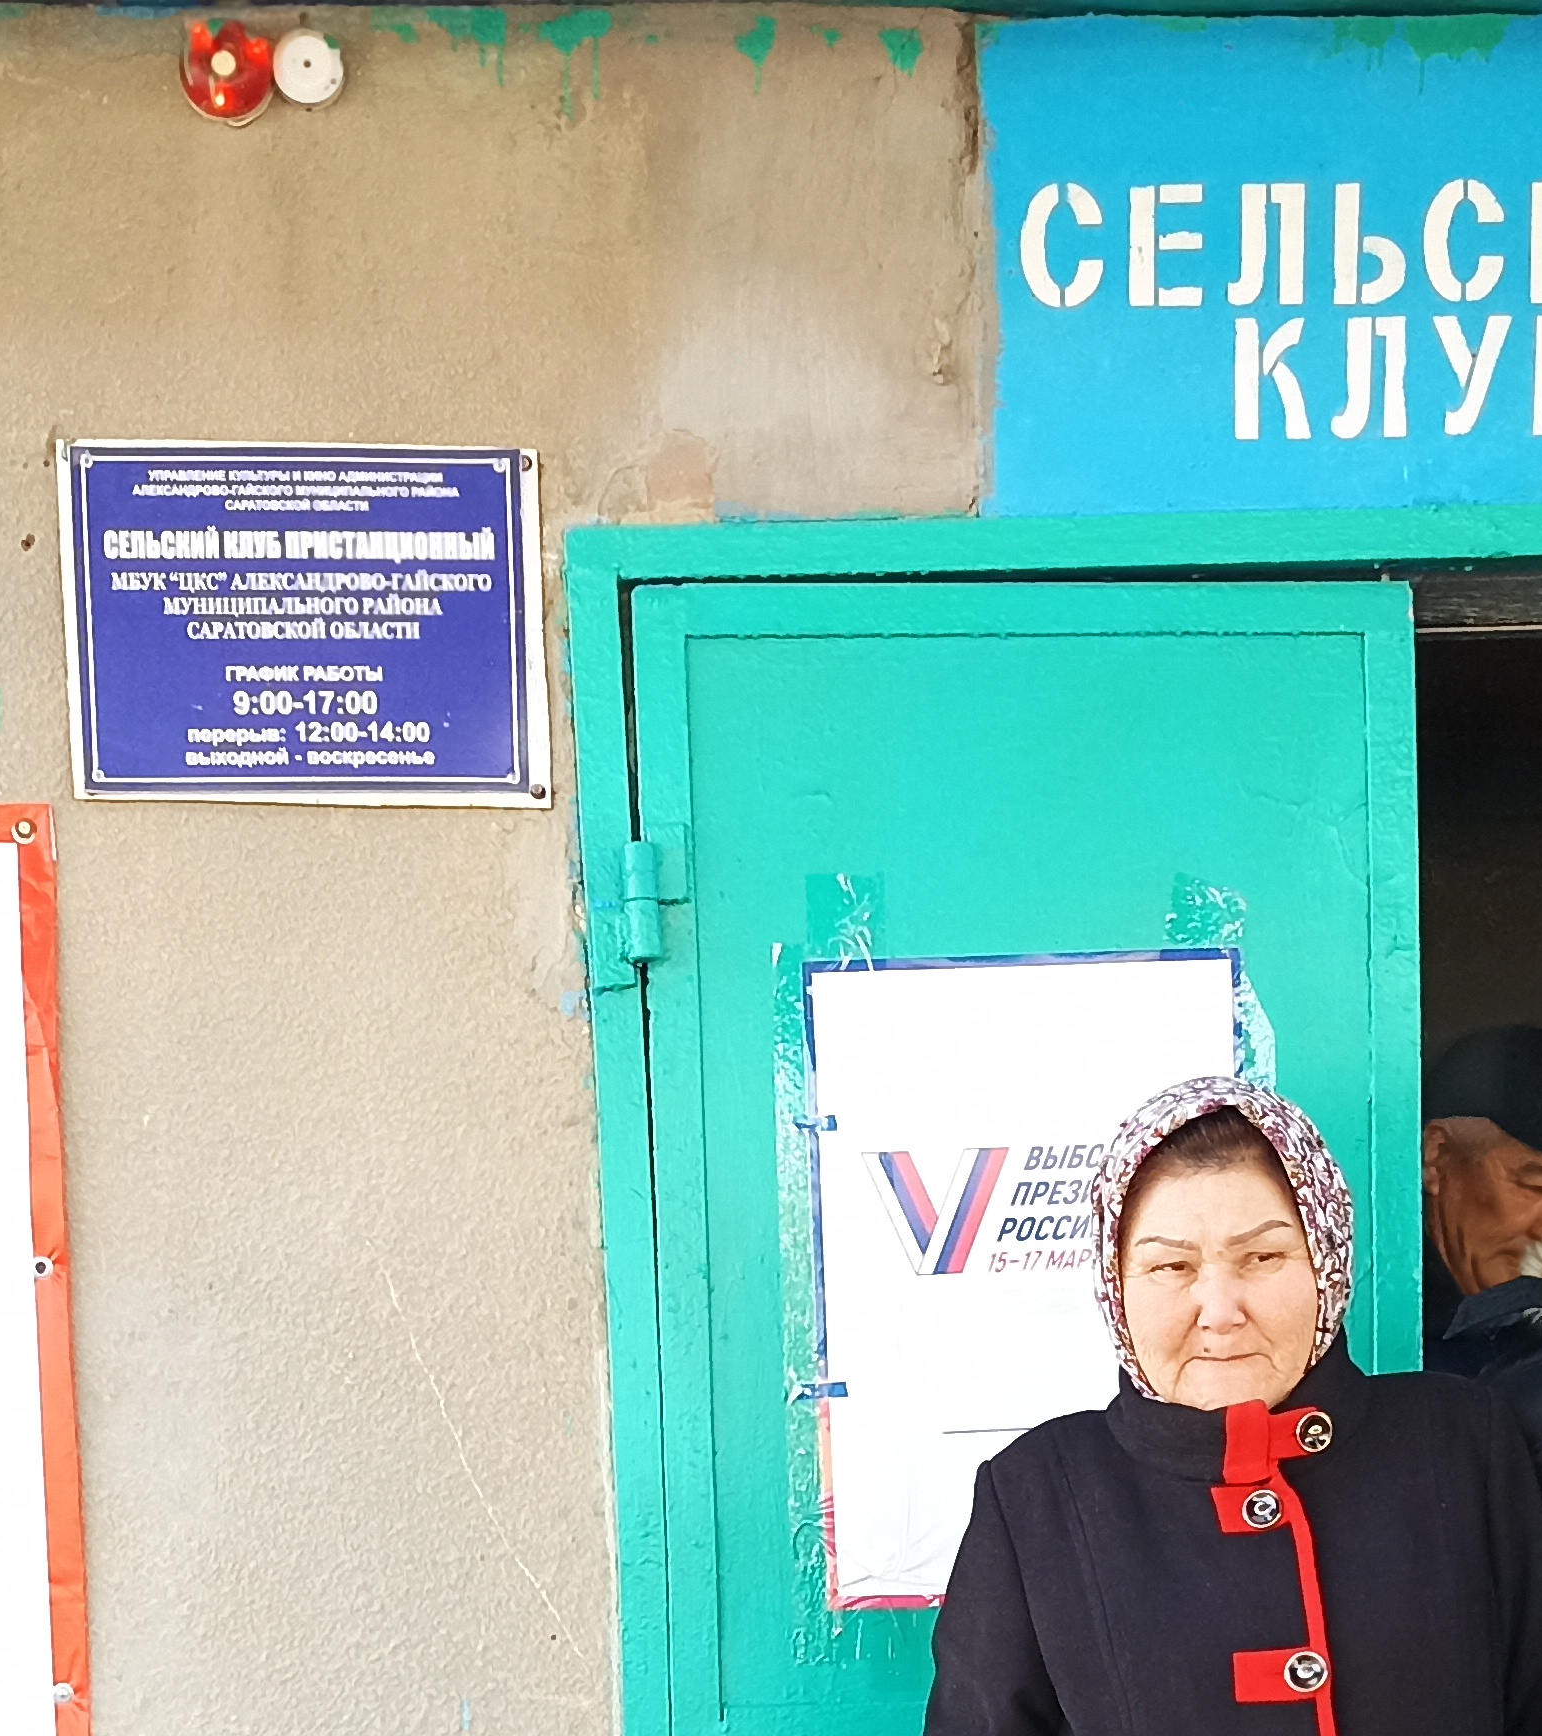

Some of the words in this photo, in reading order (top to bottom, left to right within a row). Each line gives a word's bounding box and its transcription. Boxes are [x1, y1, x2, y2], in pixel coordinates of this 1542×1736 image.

[103, 526, 220, 560] СЕЛЬСКИЙ
[224, 530, 281, 560] КЛУБ
[285, 527, 496, 563] ПРИСТАНЦИОННЫЙ
[111, 572, 167, 591] МБУК
[231, 570, 493, 593] АЛЕКСАНДРОВО-ГАЙСКОГО
[163, 597, 359, 617] МУНИЦИПАЛЬНОГО
[363, 595, 443, 616] РАЙОНА
[187, 617, 326, 640] САРАТОВСКОЙ
[330, 620, 420, 640] ОБЛАСТИ
[225, 665, 299, 682] ГРАФИК
[303, 665, 384, 682] РАБОТЫ
[233, 690, 378, 715] 9:00-17:00
[187, 728, 286, 746] перерыв:
[295, 721, 431, 742] 12:00-14:00
[185, 747, 289, 768] выходной
[307, 750, 436, 769] воскресенье
[1023, 1144, 1105, 1171] ВЫБО
[1045, 1248, 1093, 1271] МАР
